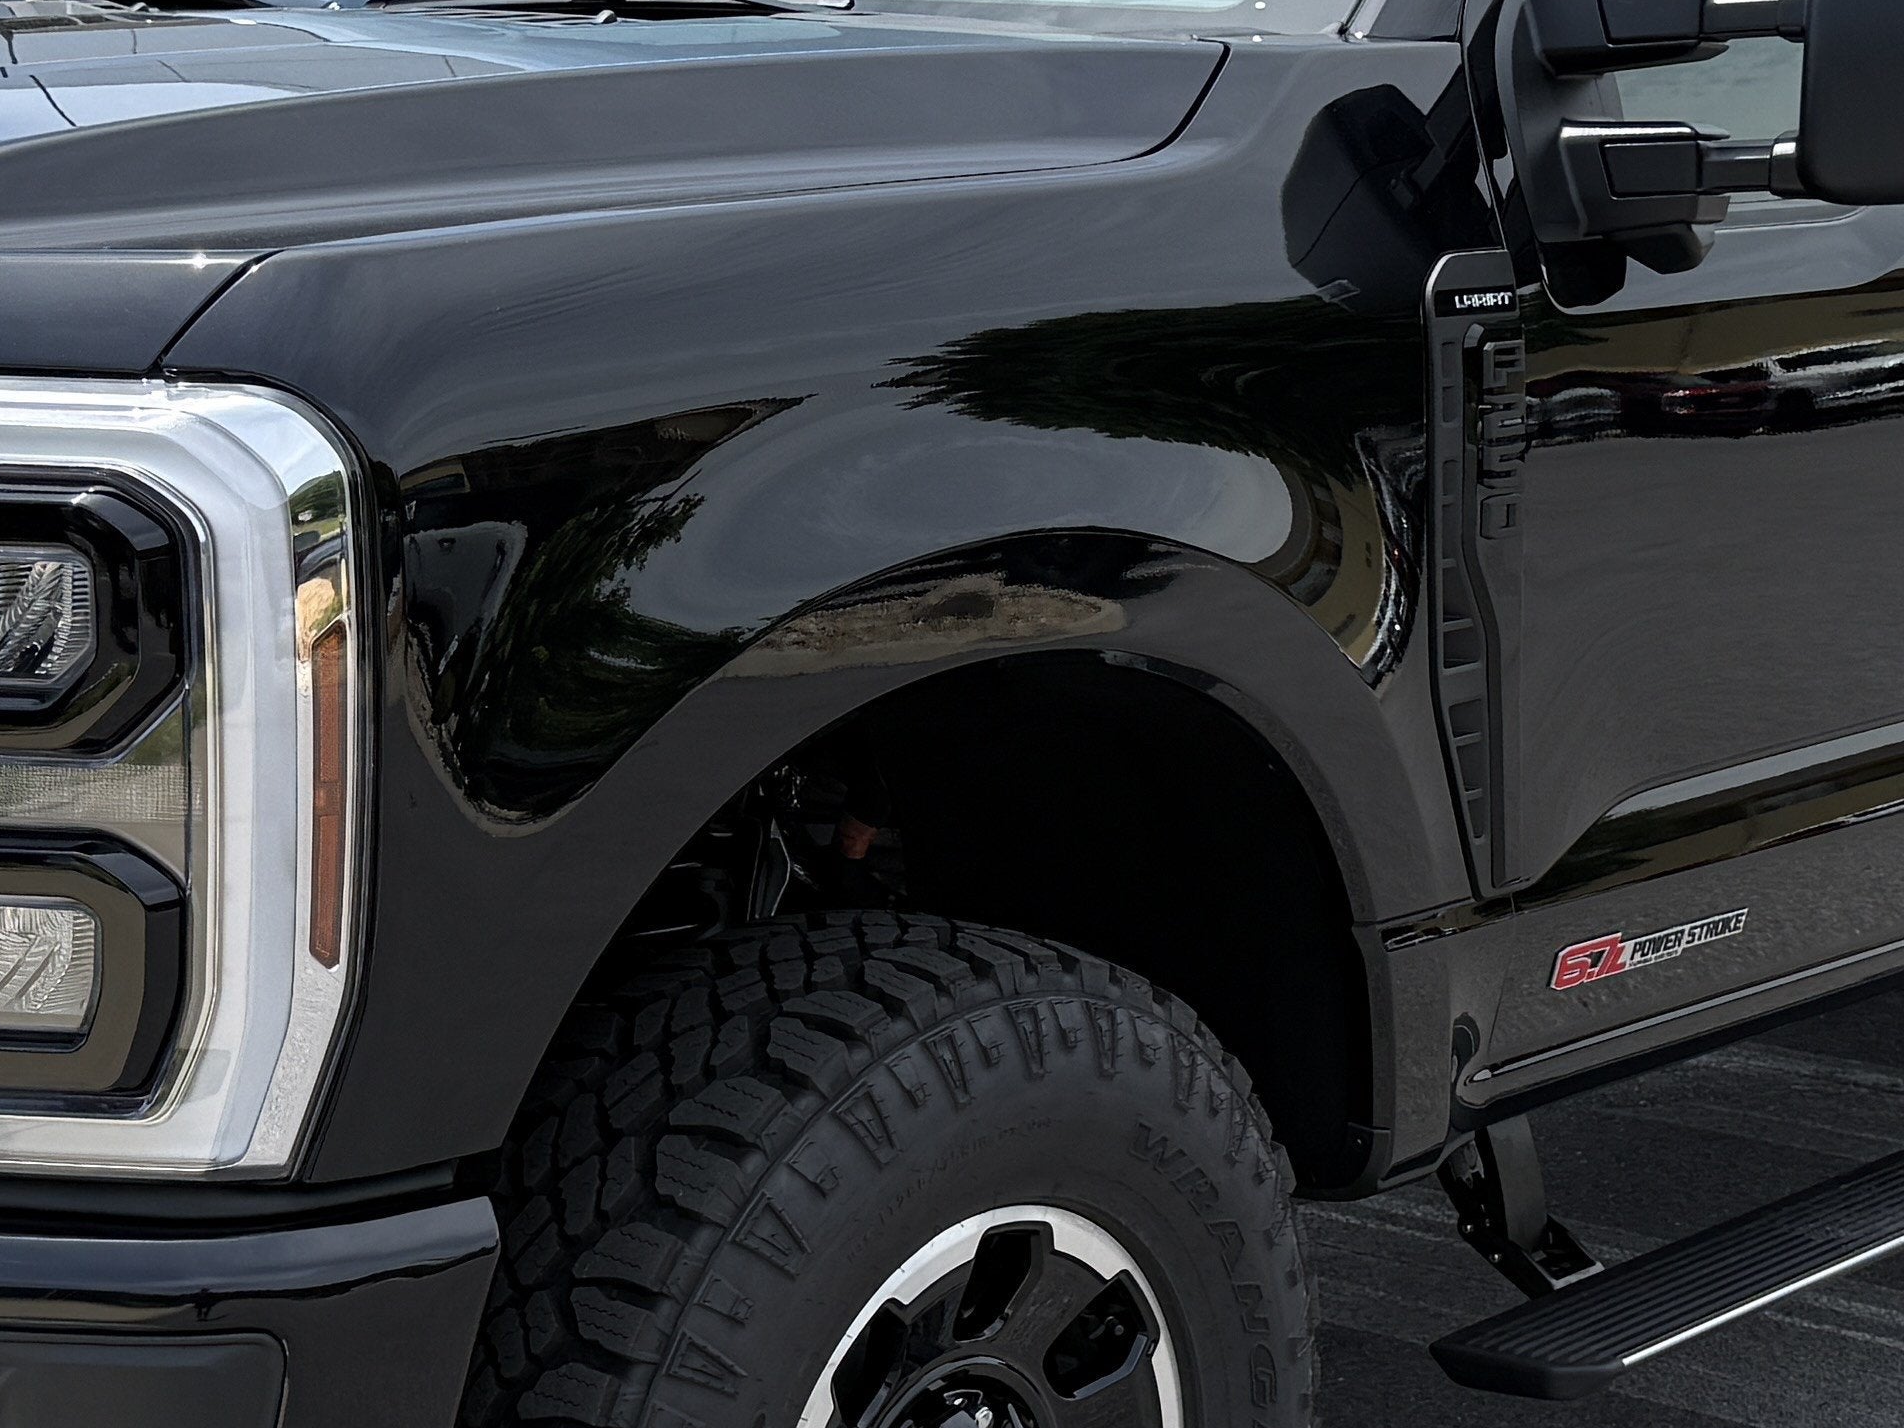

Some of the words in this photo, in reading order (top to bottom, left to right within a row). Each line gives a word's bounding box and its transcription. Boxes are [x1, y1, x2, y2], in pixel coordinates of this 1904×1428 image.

[1454, 291, 1514, 309] LARIAT
[1630, 928, 1685, 961] POWER
[1685, 912, 1746, 945] STROKE
